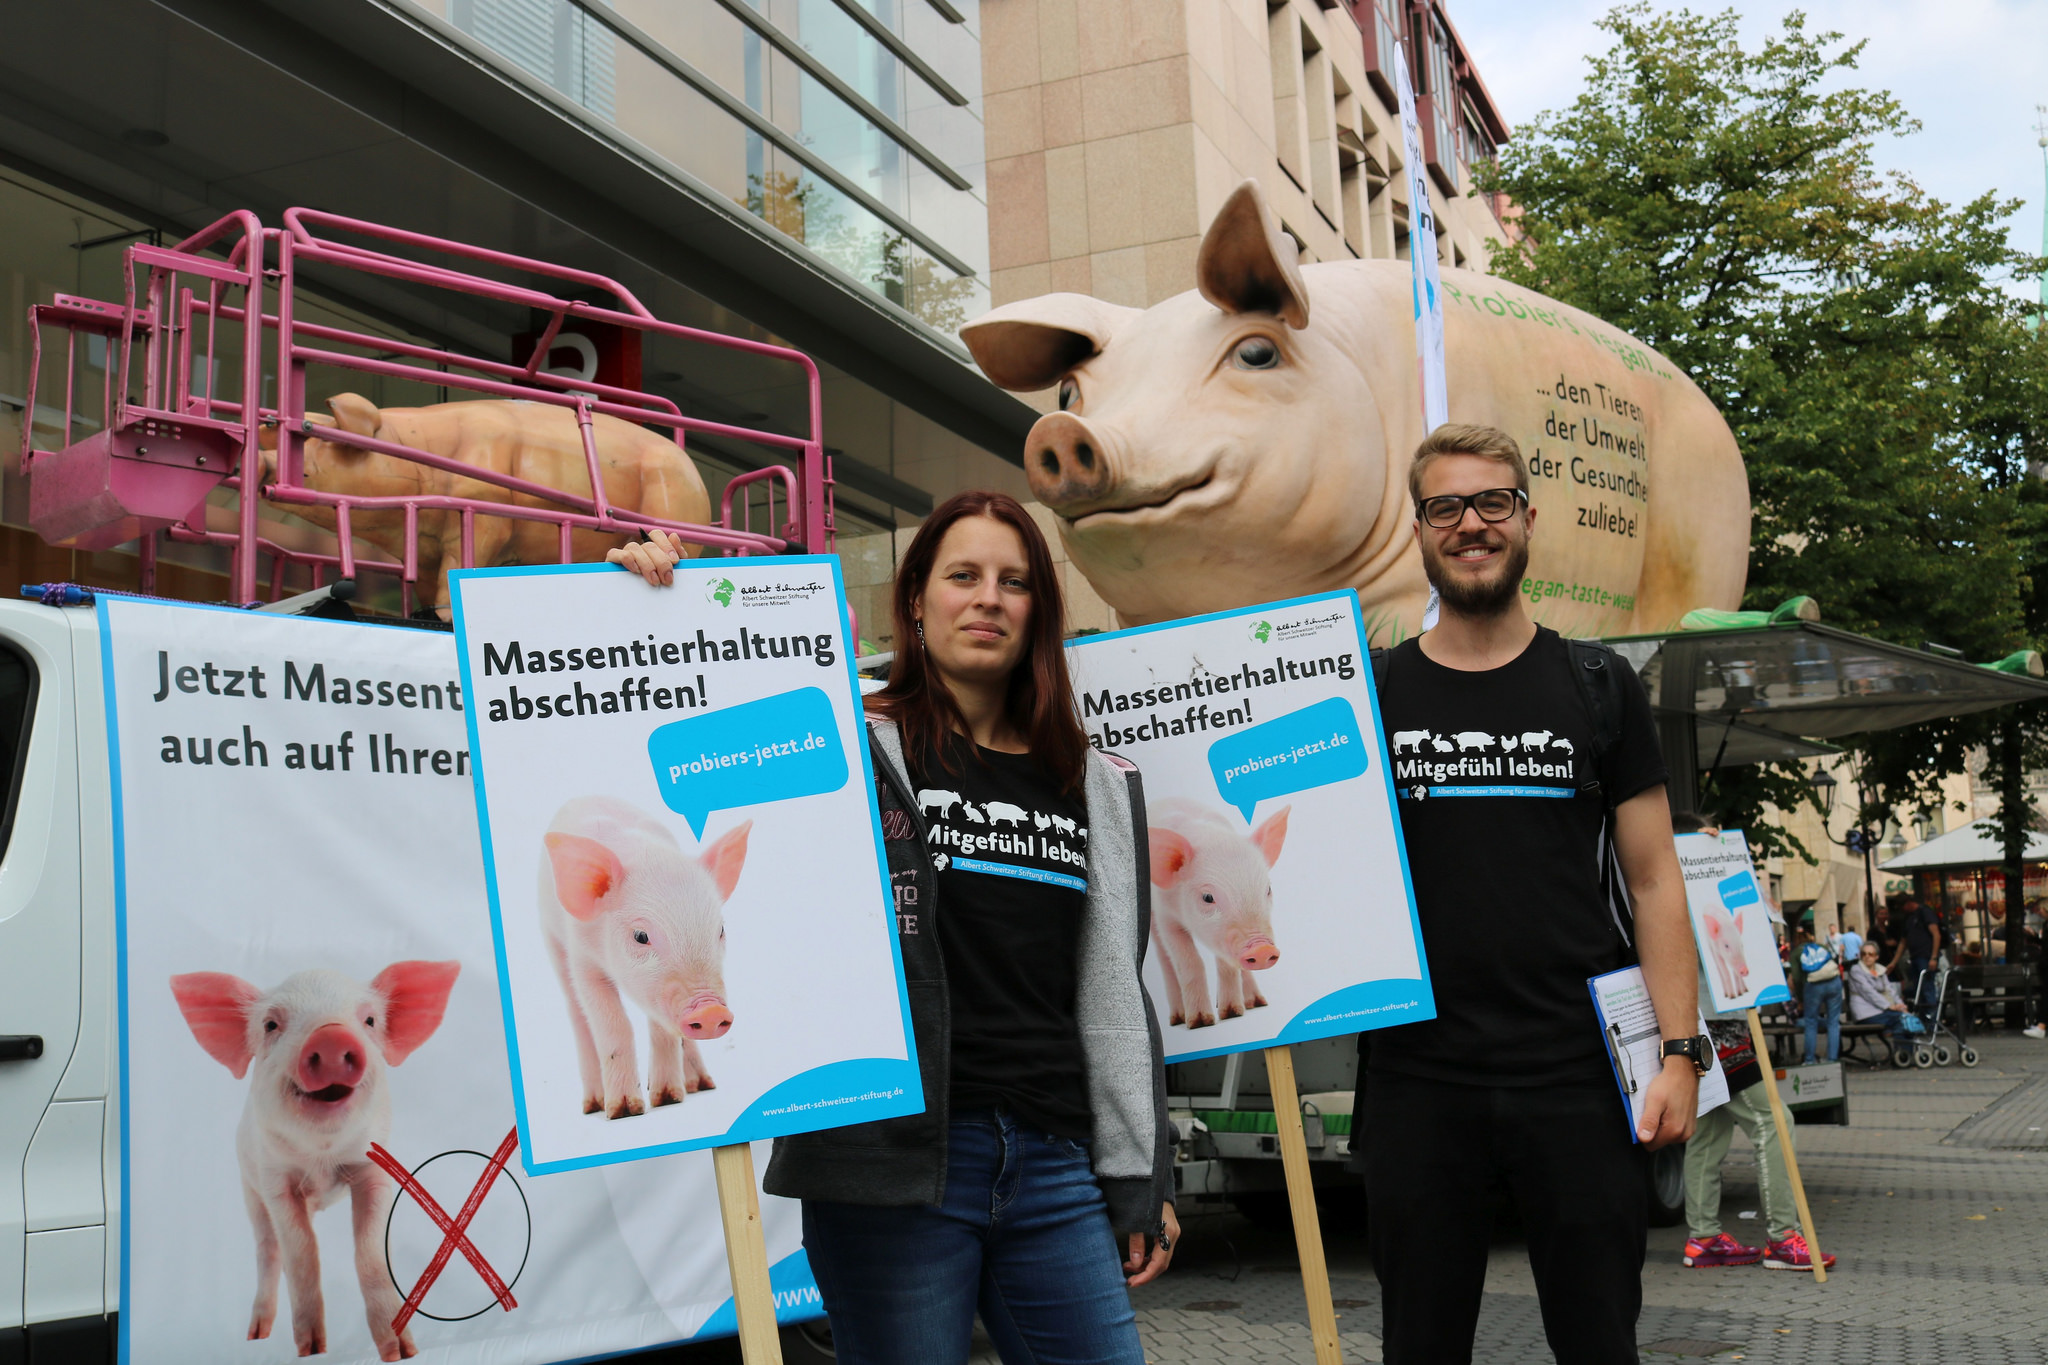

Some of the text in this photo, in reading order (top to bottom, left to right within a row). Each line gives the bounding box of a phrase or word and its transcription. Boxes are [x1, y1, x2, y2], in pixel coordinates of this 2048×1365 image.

[1442, 280, 1579, 335] Probier's
[1545, 410, 1577, 442] der
[1529, 448, 1562, 479] der
[1577, 502, 1638, 538] zuliebe!
[484, 627, 836, 676] Massentierhaltung
[153, 650, 267, 702] Jetzt
[1083, 652, 1355, 718] Massentierhaltung
[488, 675, 708, 722] abschaffen!
[1089, 698, 1253, 750] abschaffen!
[160, 725, 268, 767] auch
[285, 731, 354, 771] auf
[668, 731, 826, 784] probiers-jetzt.de
[1224, 732, 1349, 783] probiers-jetzt.de
[1396, 757, 1574, 783] Mitgefühl leben!
[1436, 787, 1455, 795] Albert
[1455, 787, 1488, 796] Schweitzer
[1489, 787, 1514, 796] Stiftung
[1514, 788, 1524, 796] für
[1545, 789, 1569, 797] Mitwelt
[960, 860, 981, 870] Albert
[982, 863, 1017, 876] Schweitzer
[1018, 868, 1043, 881] Stiftung
[1044, 872, 1053, 881] für
[1053, 875, 1072, 885] unsere
[1680, 852, 1749, 868] Massentierhaltung
[1303, 1000, 1418, 1025] www.albert-schweitzer-stiftung.de
[762, 1087, 904, 1117] www.albert-schweitzer-stiftung.de
